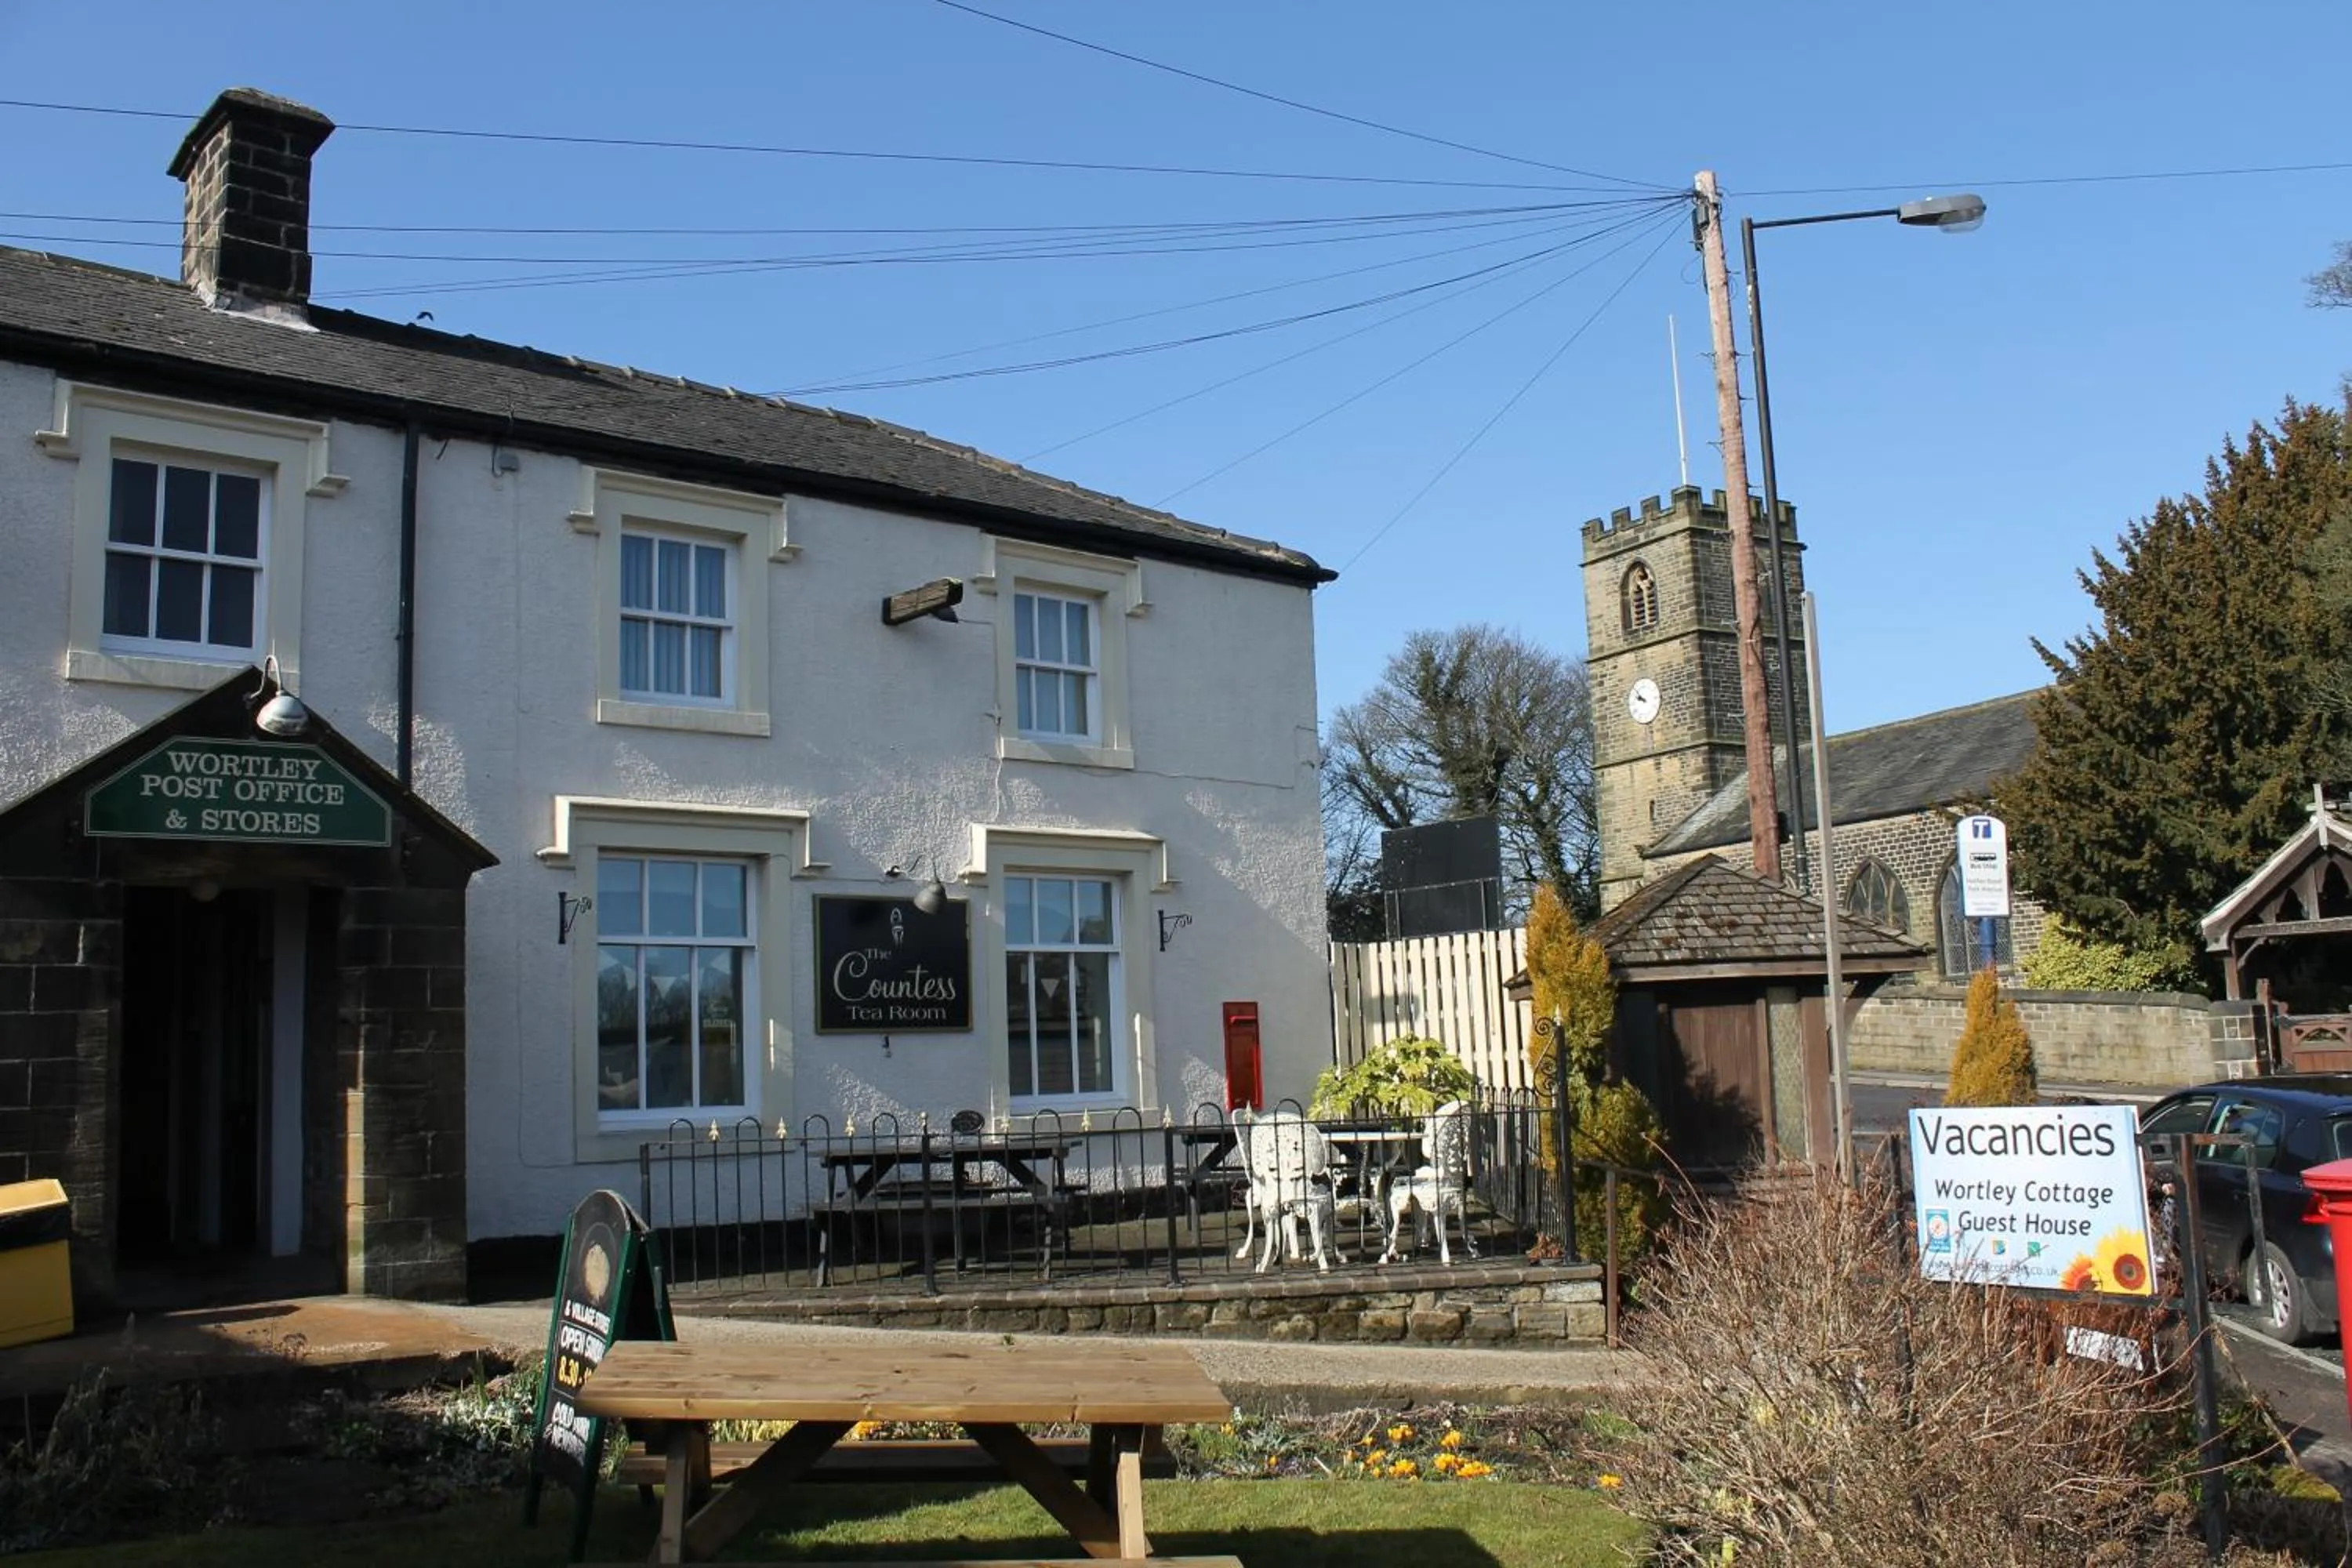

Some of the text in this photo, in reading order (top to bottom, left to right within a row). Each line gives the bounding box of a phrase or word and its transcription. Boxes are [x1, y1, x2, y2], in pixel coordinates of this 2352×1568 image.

[167, 751, 322, 781] WORTLEY
[140, 775, 344, 805] POST OFFICE
[165, 808, 320, 834] & STORES
[865, 948, 891, 960] The
[833, 951, 956, 1001] Countess
[846, 1005, 947, 1020] Tea Room
[1918, 1114, 2115, 1156] Vacancies
[1935, 1178, 2114, 1208] Wortley Cottage
[1958, 1211, 2092, 1236] Guest House
[561, 1325, 586, 1355] OPEN
